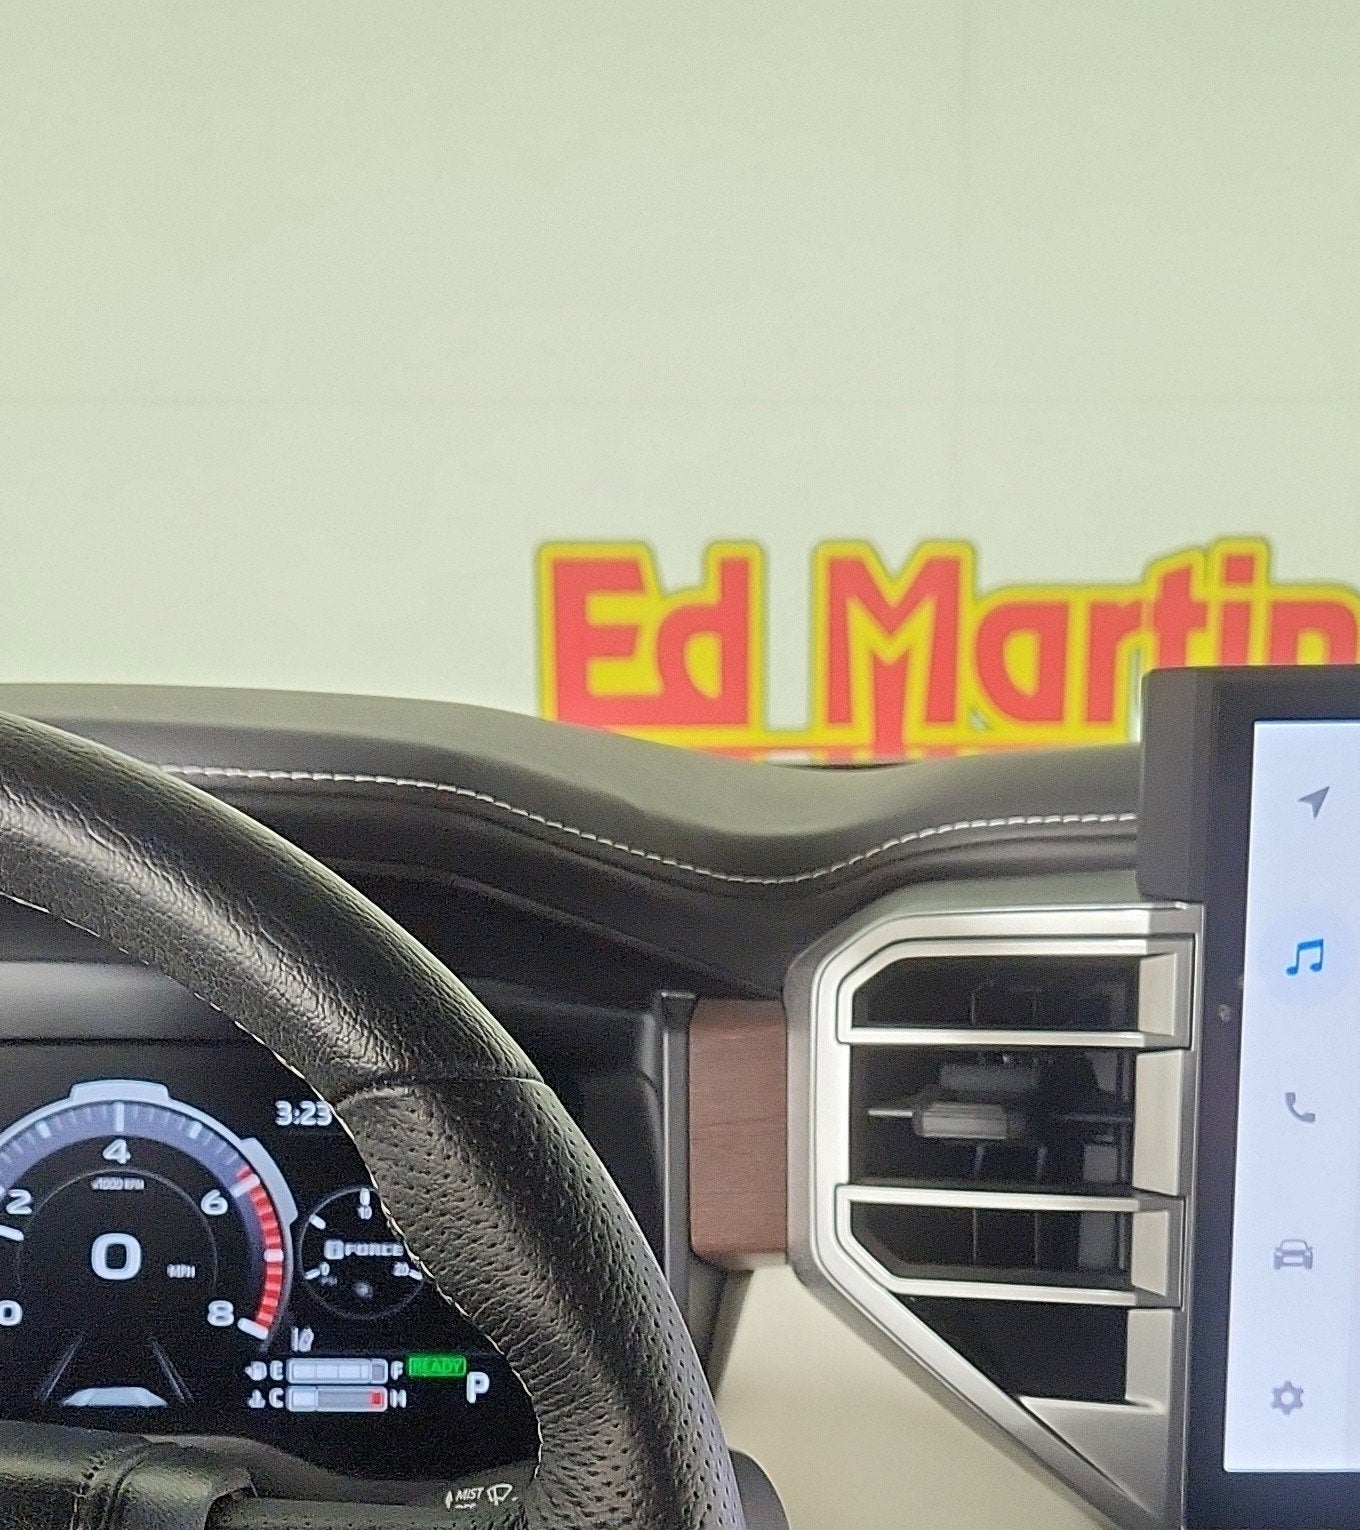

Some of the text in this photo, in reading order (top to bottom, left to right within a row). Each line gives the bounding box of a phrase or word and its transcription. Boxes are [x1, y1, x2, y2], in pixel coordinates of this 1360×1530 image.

[545, 550, 758, 730] Ed
[275, 1100, 333, 1126] 3:23
[103, 1139, 130, 1164] 4
[7, 1190, 33, 1216] 2
[201, 1189, 228, 1216] 6
[91, 1231, 142, 1281] 0
[207, 1300, 235, 1327] 8
[391, 1360, 403, 1380] F
[411, 1357, 462, 1373] READY
[269, 1389, 284, 1408] C
[390, 1389, 407, 1408] H
[467, 1371, 490, 1404] P
[455, 1487, 485, 1501] MIST
